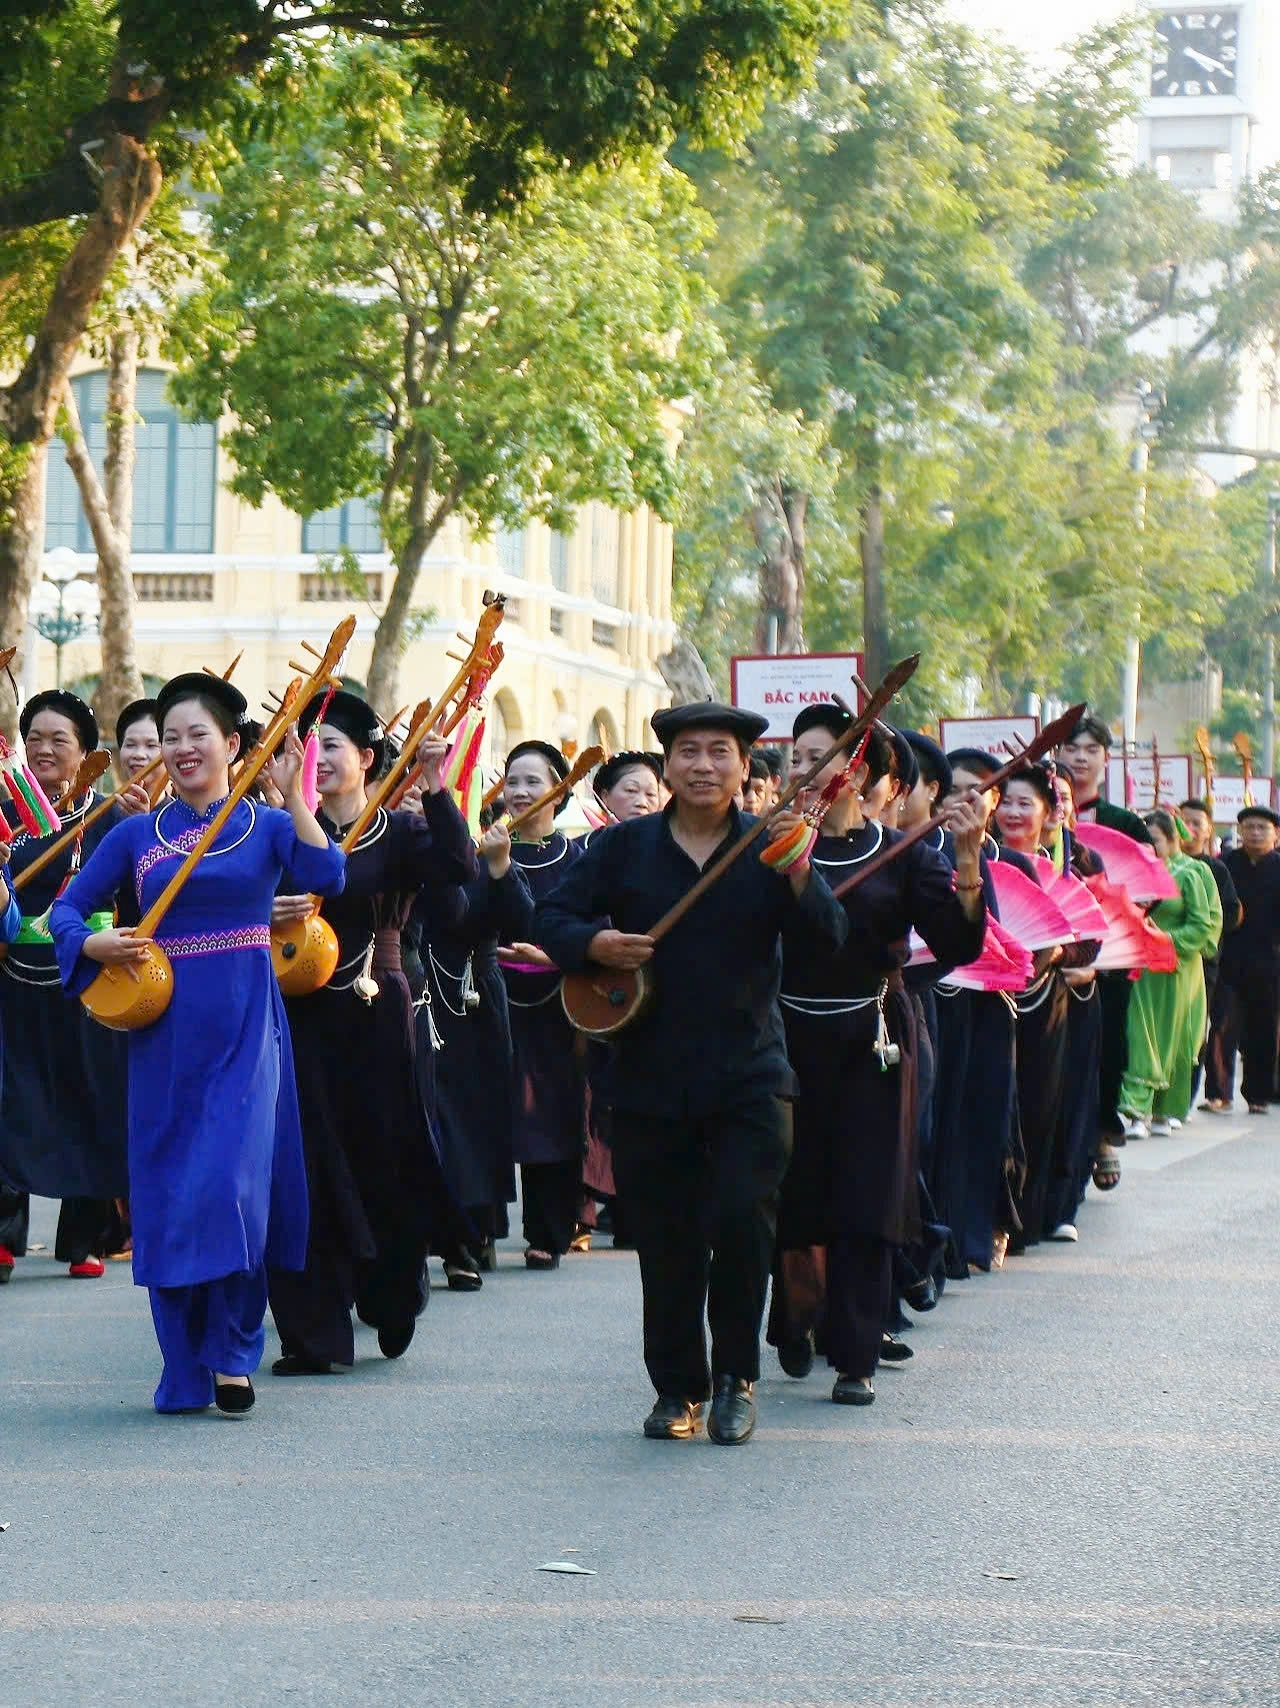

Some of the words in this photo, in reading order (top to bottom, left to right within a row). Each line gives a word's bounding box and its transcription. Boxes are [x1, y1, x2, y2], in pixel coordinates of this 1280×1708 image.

[1221, 46, 1237, 61] 3
[1184, 80, 1201, 96] 6
[764, 688, 794, 704] BẮC
